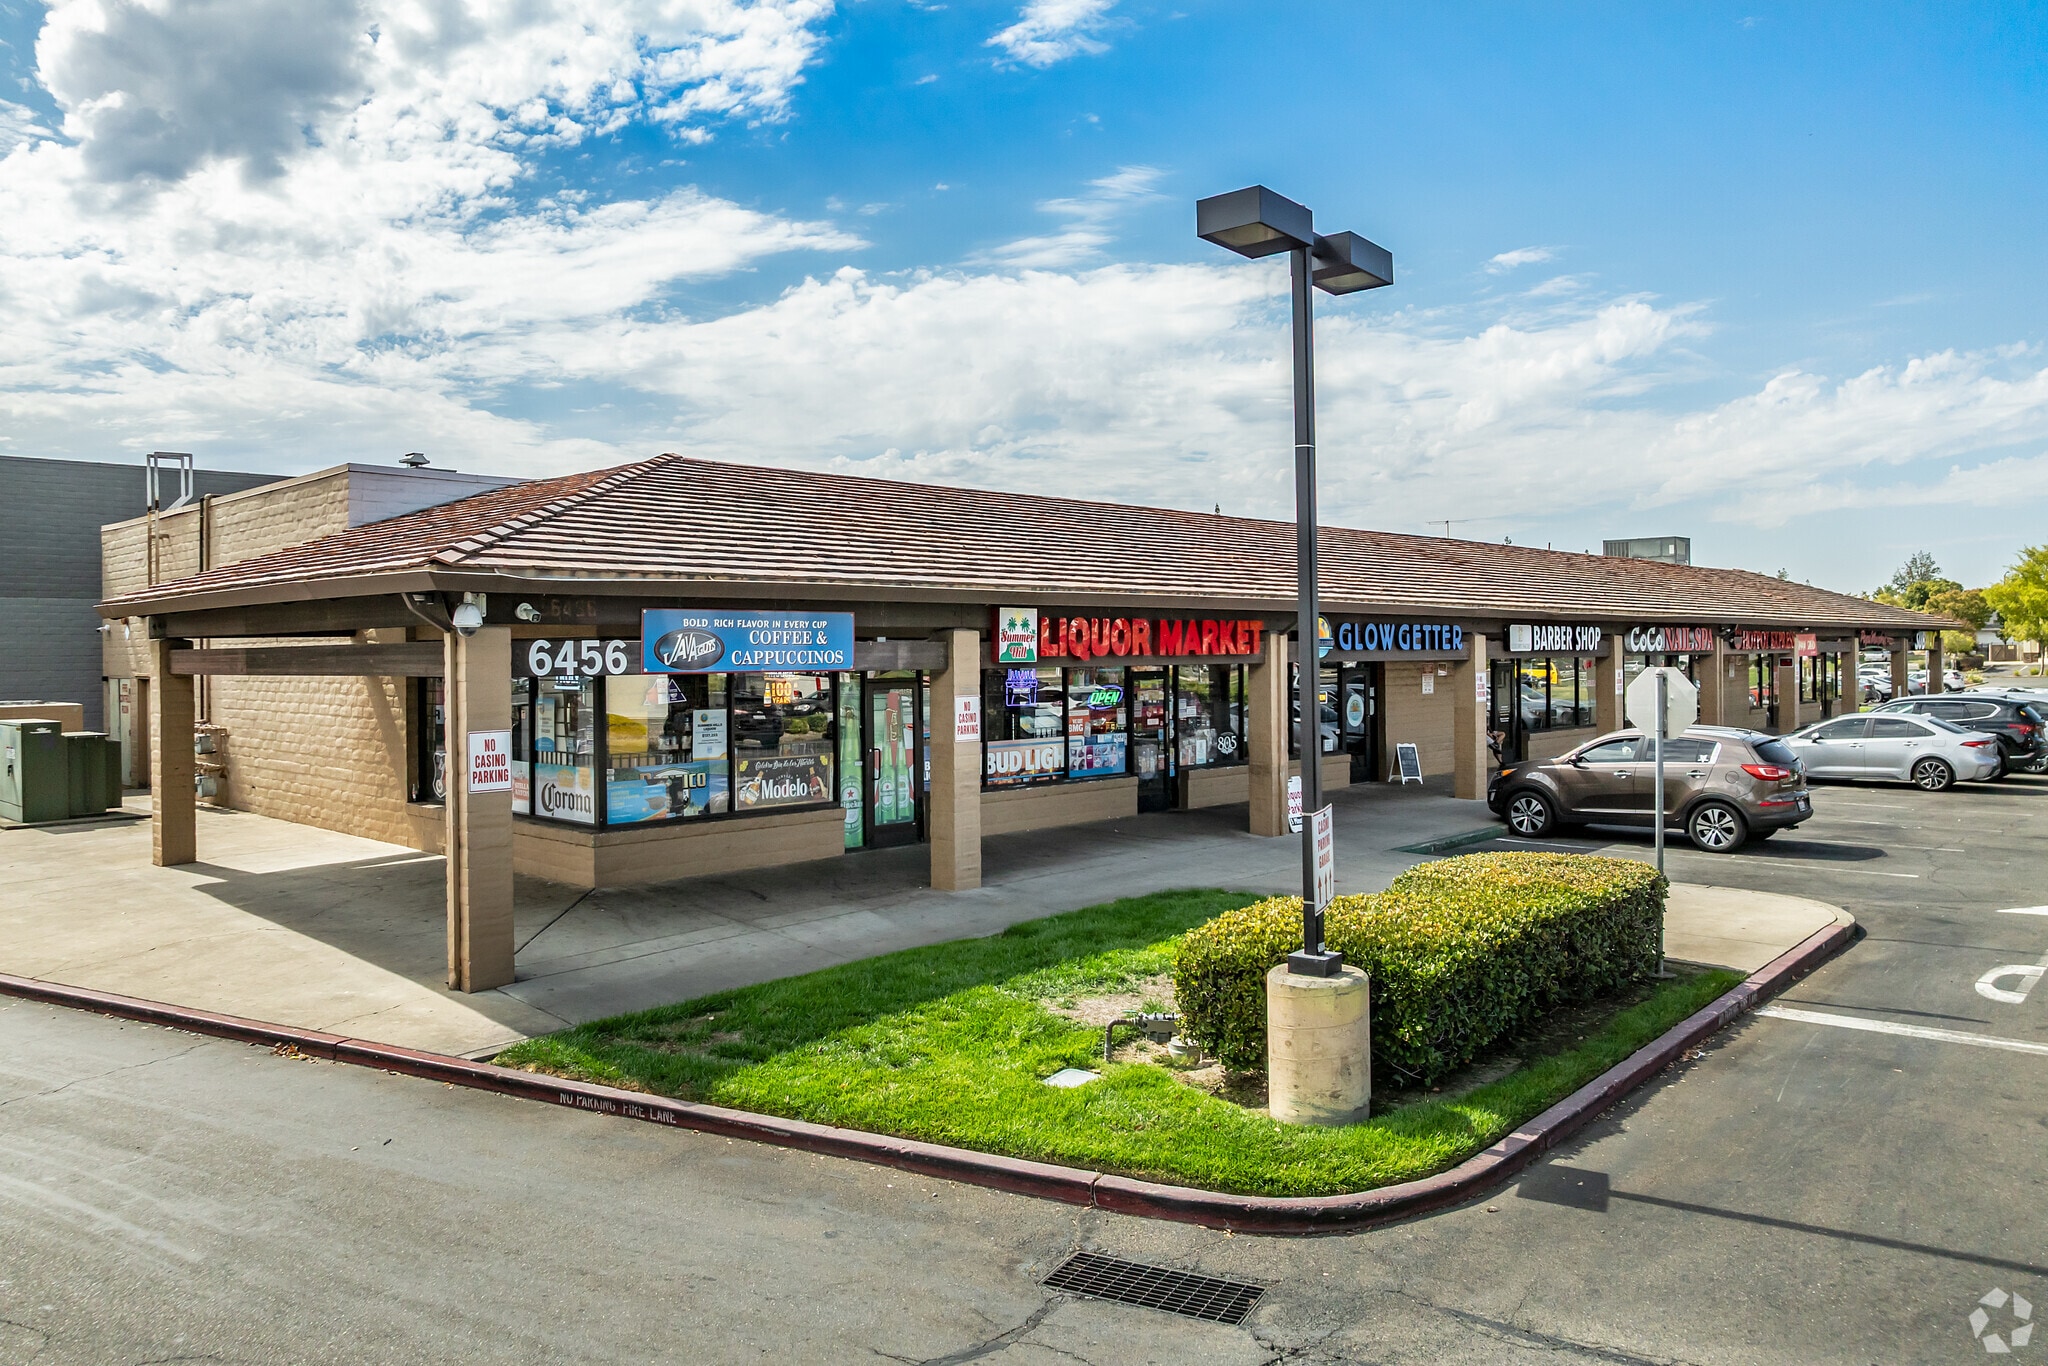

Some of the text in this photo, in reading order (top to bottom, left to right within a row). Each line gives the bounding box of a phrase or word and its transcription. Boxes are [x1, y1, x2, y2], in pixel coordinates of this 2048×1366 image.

[714, 619, 734, 628] RICH
[737, 619, 769, 628] FLAVOR
[772, 620, 781, 629] IN
[784, 620, 810, 629] EVERY
[812, 620, 828, 629] CUP
[749, 630, 828, 645] COFFEE &
[1000, 631, 1035, 643] Summer
[1040, 617, 1264, 661] LIQUOR MARKET
[1339, 622, 1463, 651] GLOW GETTER
[1533, 625, 1573, 651] BARBER
[1575, 626, 1601, 651] SHOP
[1664, 627, 1692, 651] NAIL
[1693, 627, 1714, 651] SPA
[528, 639, 628, 676] 6456
[663, 632, 717, 667] JAVA GUYS
[731, 649, 844, 665] CAPPUCCINOS
[771, 681, 792, 697] 100
[963, 701, 971, 711] NO
[1089, 690, 1120, 706] OPEN
[959, 713, 977, 723] CASINO
[957, 724, 979, 735] PARKING
[484, 738, 496, 752] NO
[1217, 735, 1237, 751] 805
[475, 753, 506, 768] CASINO
[988, 750, 1022, 775] BUD
[472, 769, 509, 784] PARKING
[761, 778, 808, 800] Modelo
[541, 782, 592, 816] Corona
[560, 1092, 677, 1124] NO PARKING FIRE LANE
